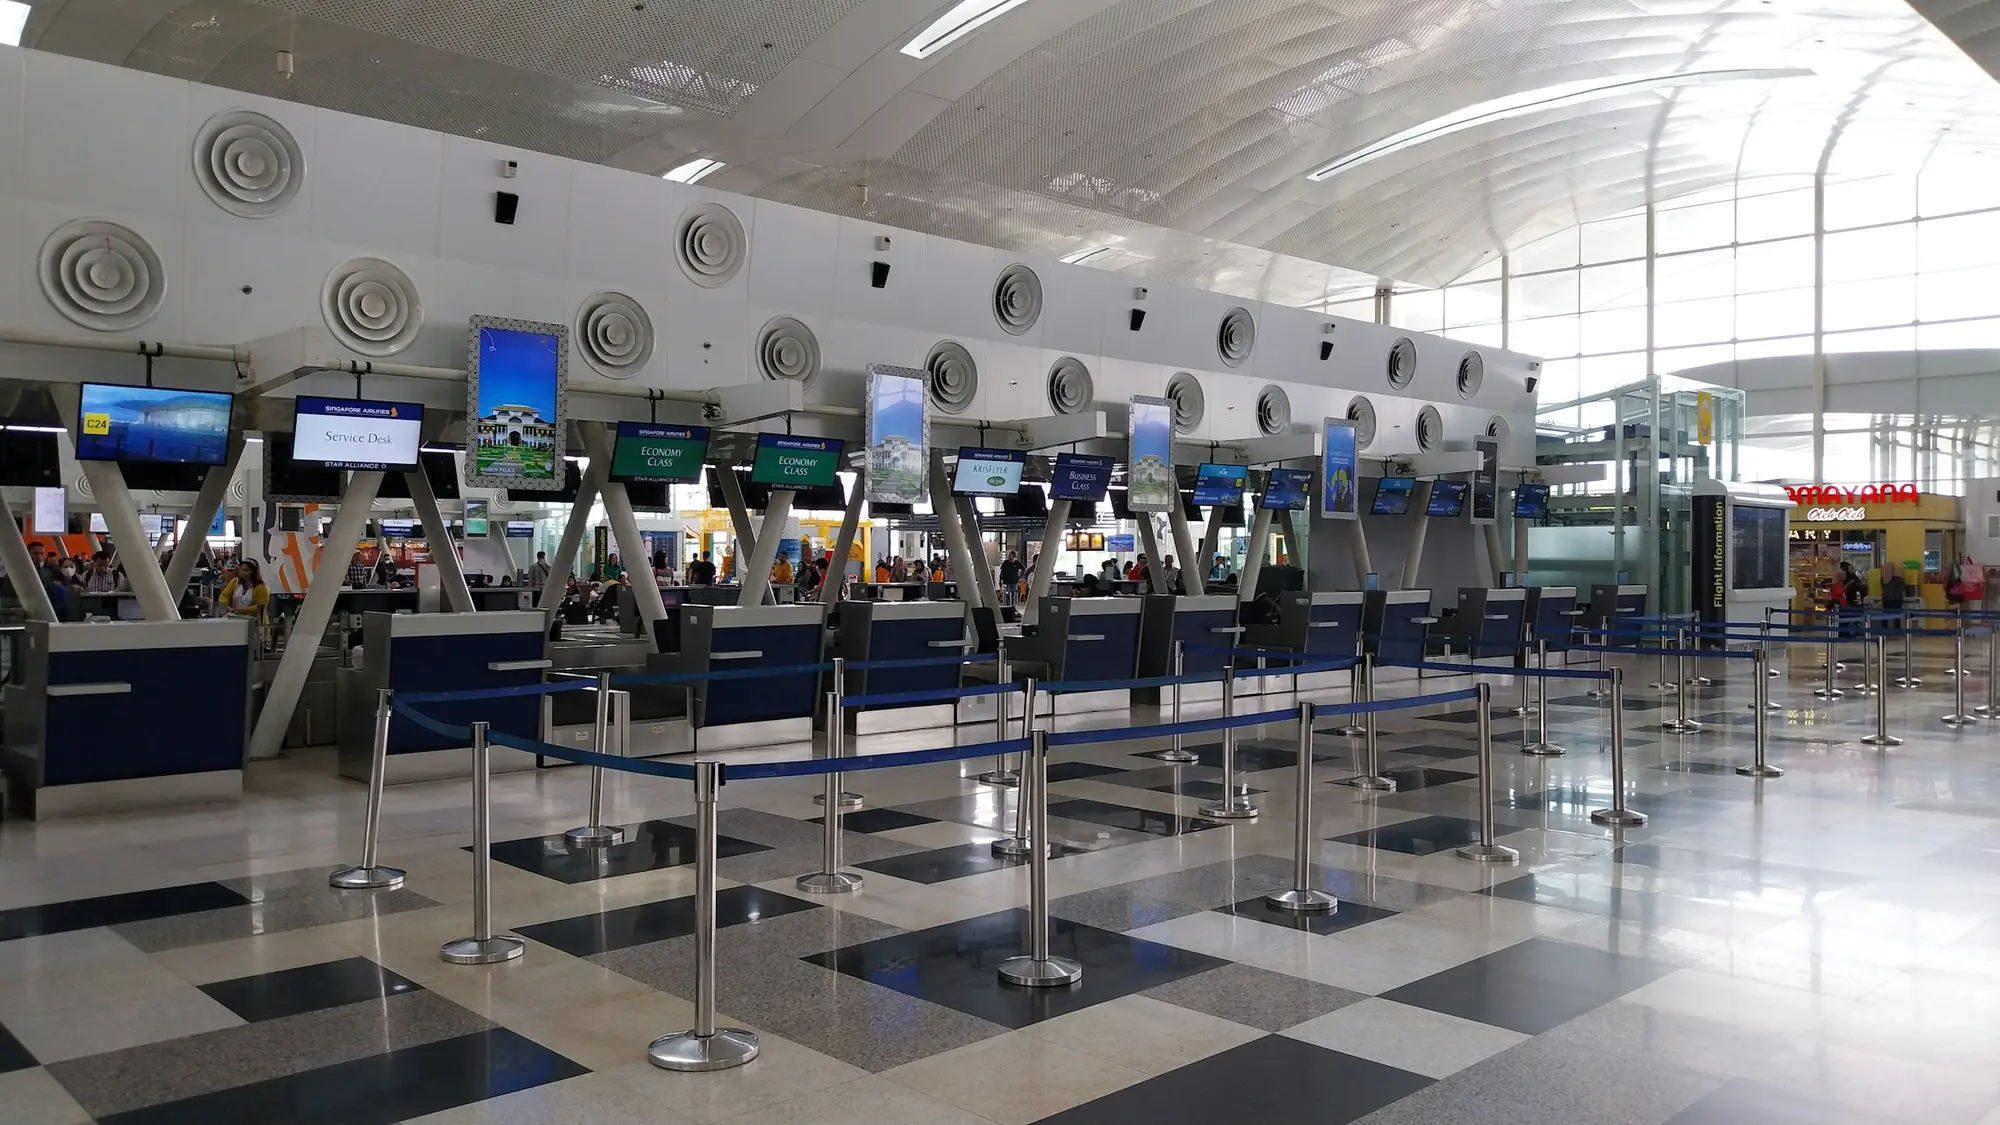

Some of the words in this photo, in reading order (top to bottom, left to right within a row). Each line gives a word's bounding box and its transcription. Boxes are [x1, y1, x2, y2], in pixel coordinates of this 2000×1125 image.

[325, 405, 361, 413] SINGAPORE
[87, 419, 106, 428] C24
[325, 431, 365, 443] Service
[368, 433, 392, 444] Desk
[641, 446, 683, 457] ECONOMY
[647, 457, 673, 467] CLASS
[778, 456, 818, 467] ECONOMY
[784, 466, 808, 476] CLASS
[1069, 470, 1097, 481] BUSINESS
[1071, 481, 1090, 490] CLASS
[1713, 501, 1723, 571] Information
[1713, 573, 1723, 607] Flight
